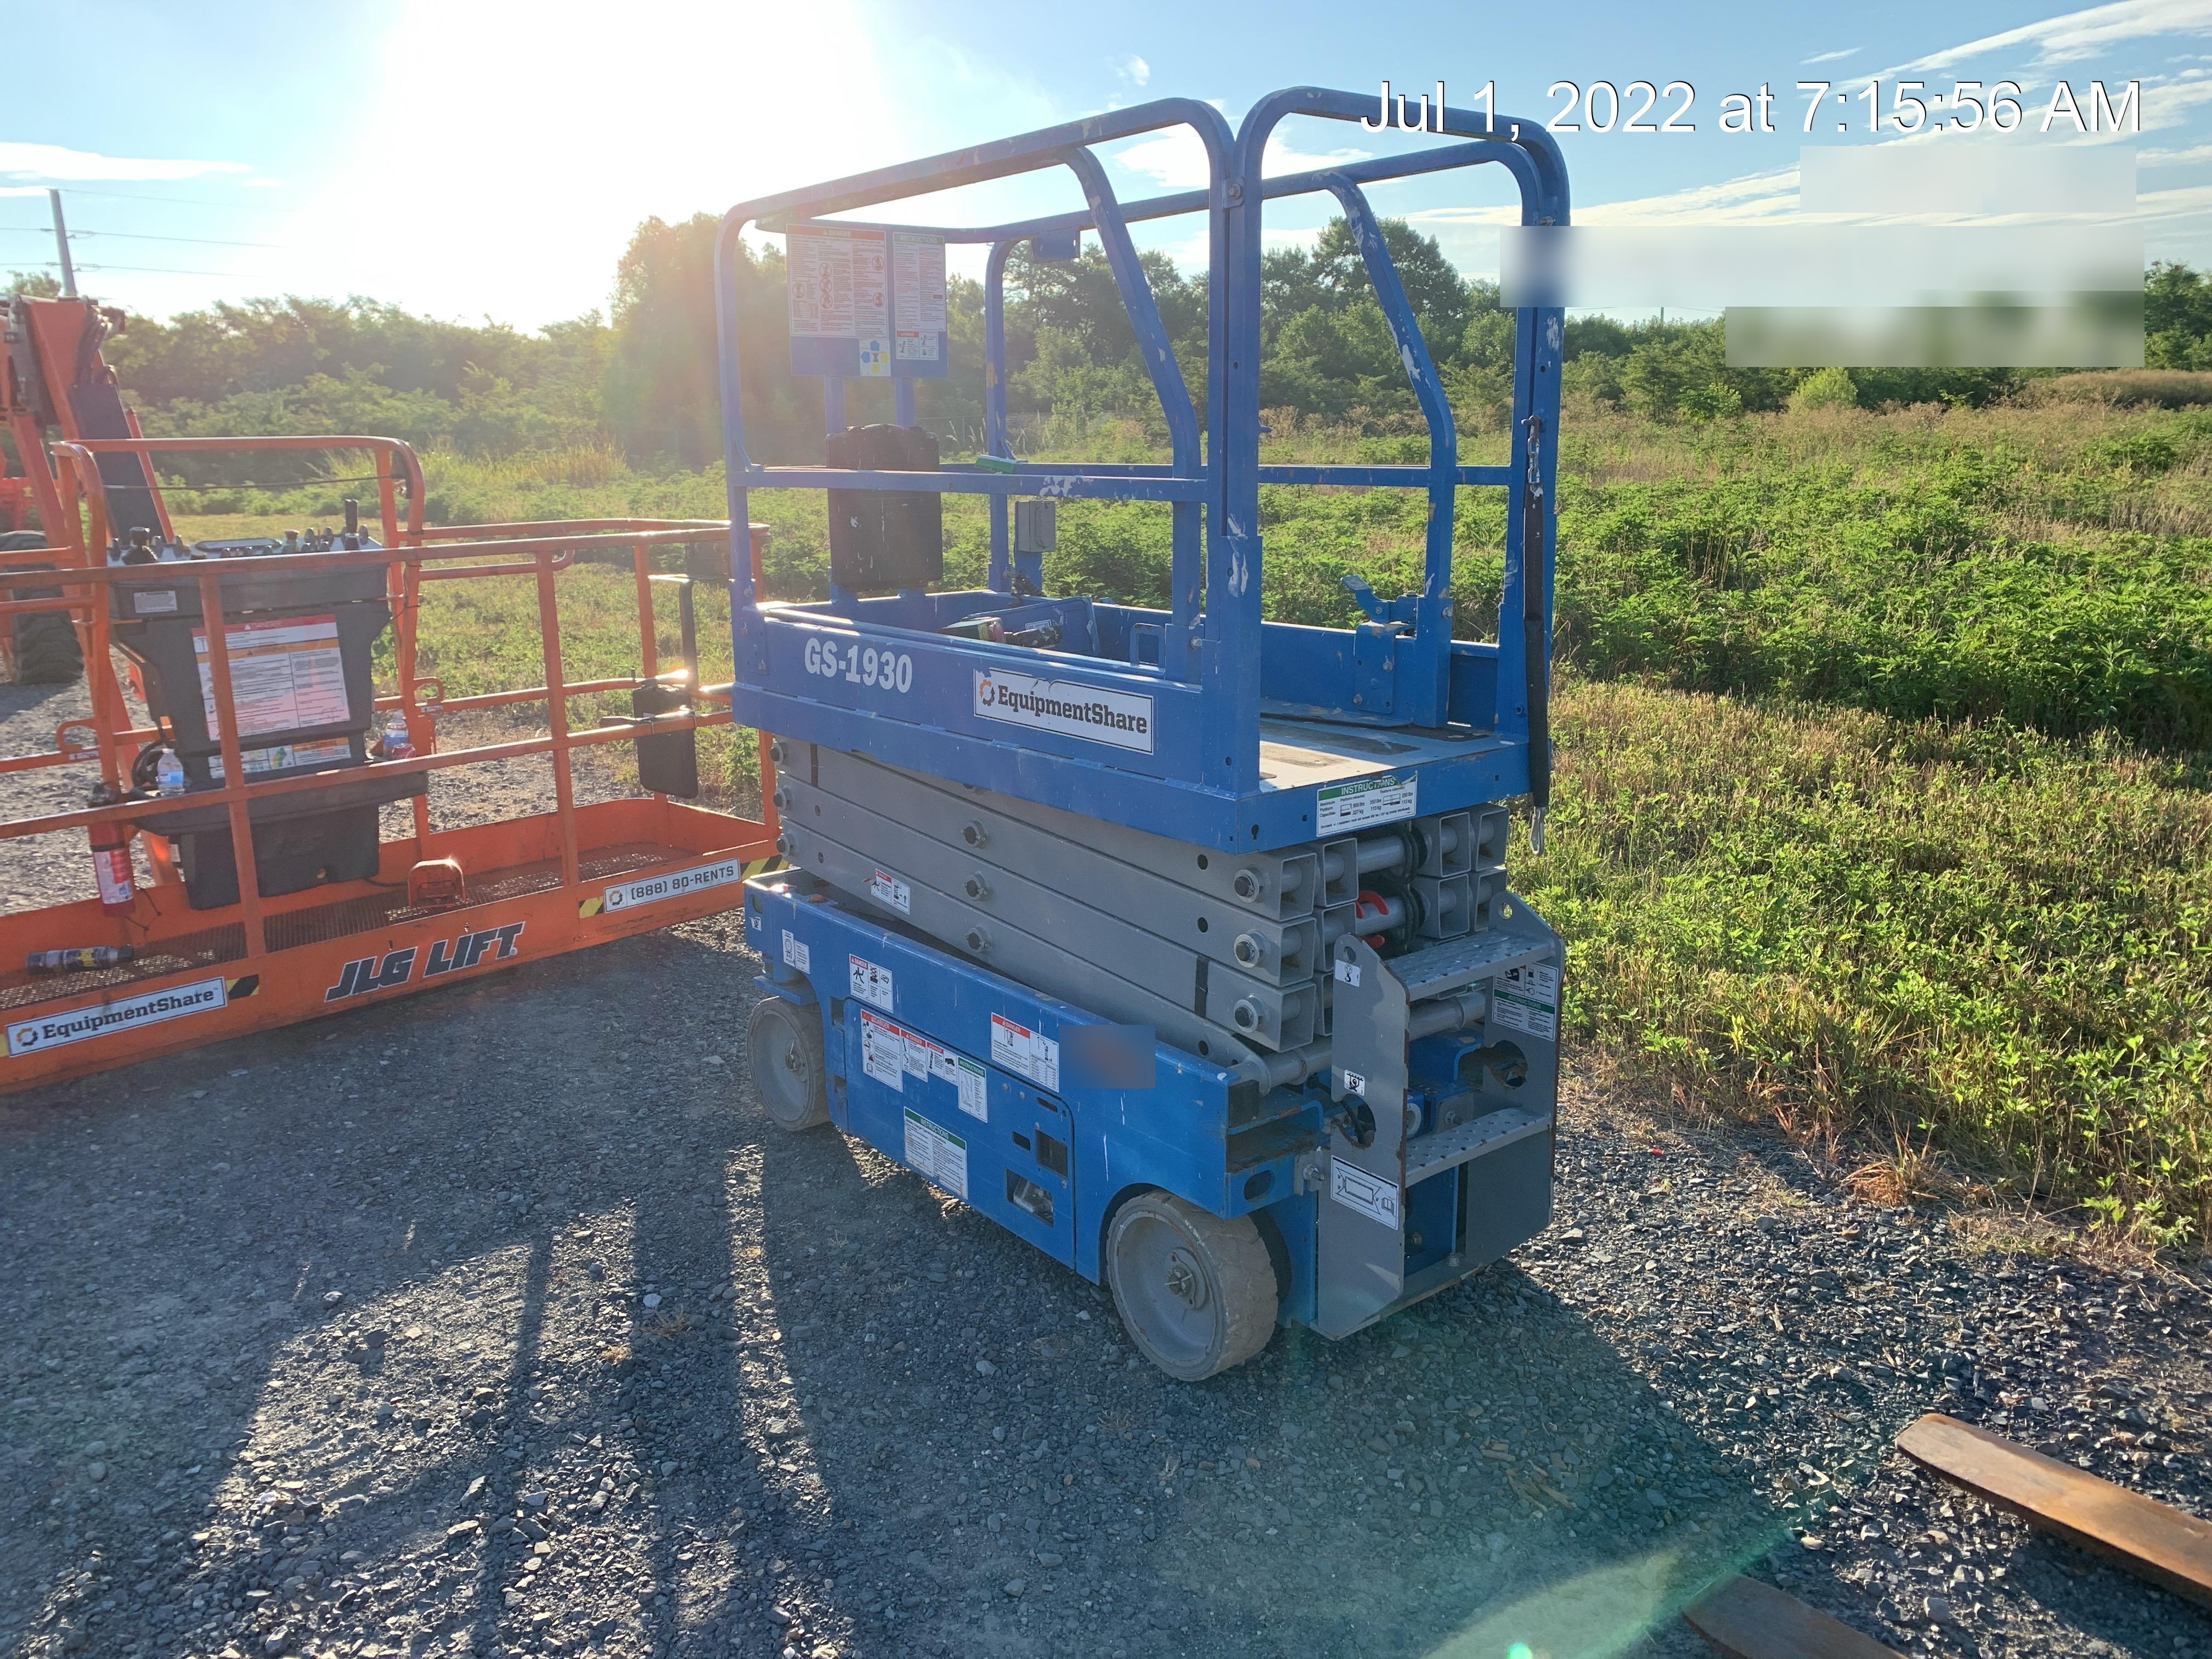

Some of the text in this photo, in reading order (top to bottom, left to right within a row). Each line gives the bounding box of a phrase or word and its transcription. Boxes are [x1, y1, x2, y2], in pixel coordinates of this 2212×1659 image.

[900, 233, 938, 244] INSTRUCTIONS
[805, 637, 912, 693] GS-1930
[998, 685, 1147, 733] EquipmentShare
[631, 865, 734, 900] (888) 80-RENTS
[324, 921, 526, 1003] JLG LIFT
[42, 989, 215, 1039] EquipmentShare
[920, 1118, 949, 1140] INSTRUCTIONS
